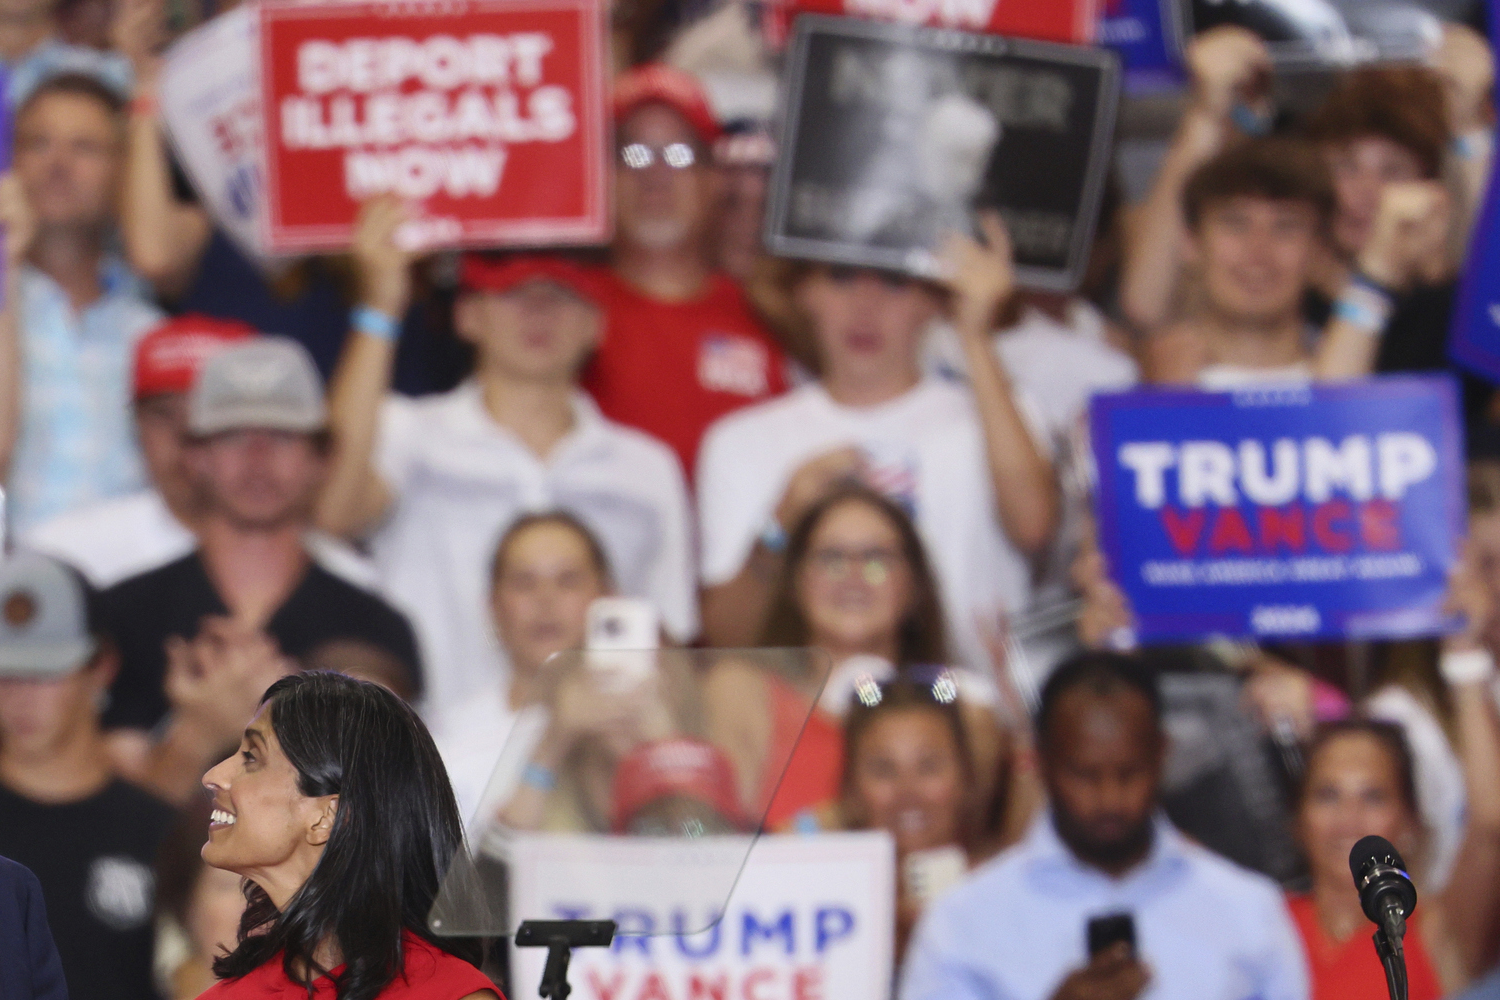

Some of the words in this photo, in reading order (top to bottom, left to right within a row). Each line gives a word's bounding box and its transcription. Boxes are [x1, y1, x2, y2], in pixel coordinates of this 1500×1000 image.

[296, 32, 554, 94] DEPORT
[279, 85, 576, 151] ILLEGALS
[344, 145, 508, 200] NOW
[1117, 431, 1438, 508] TRUMP
[1160, 496, 1404, 558] VANCE
